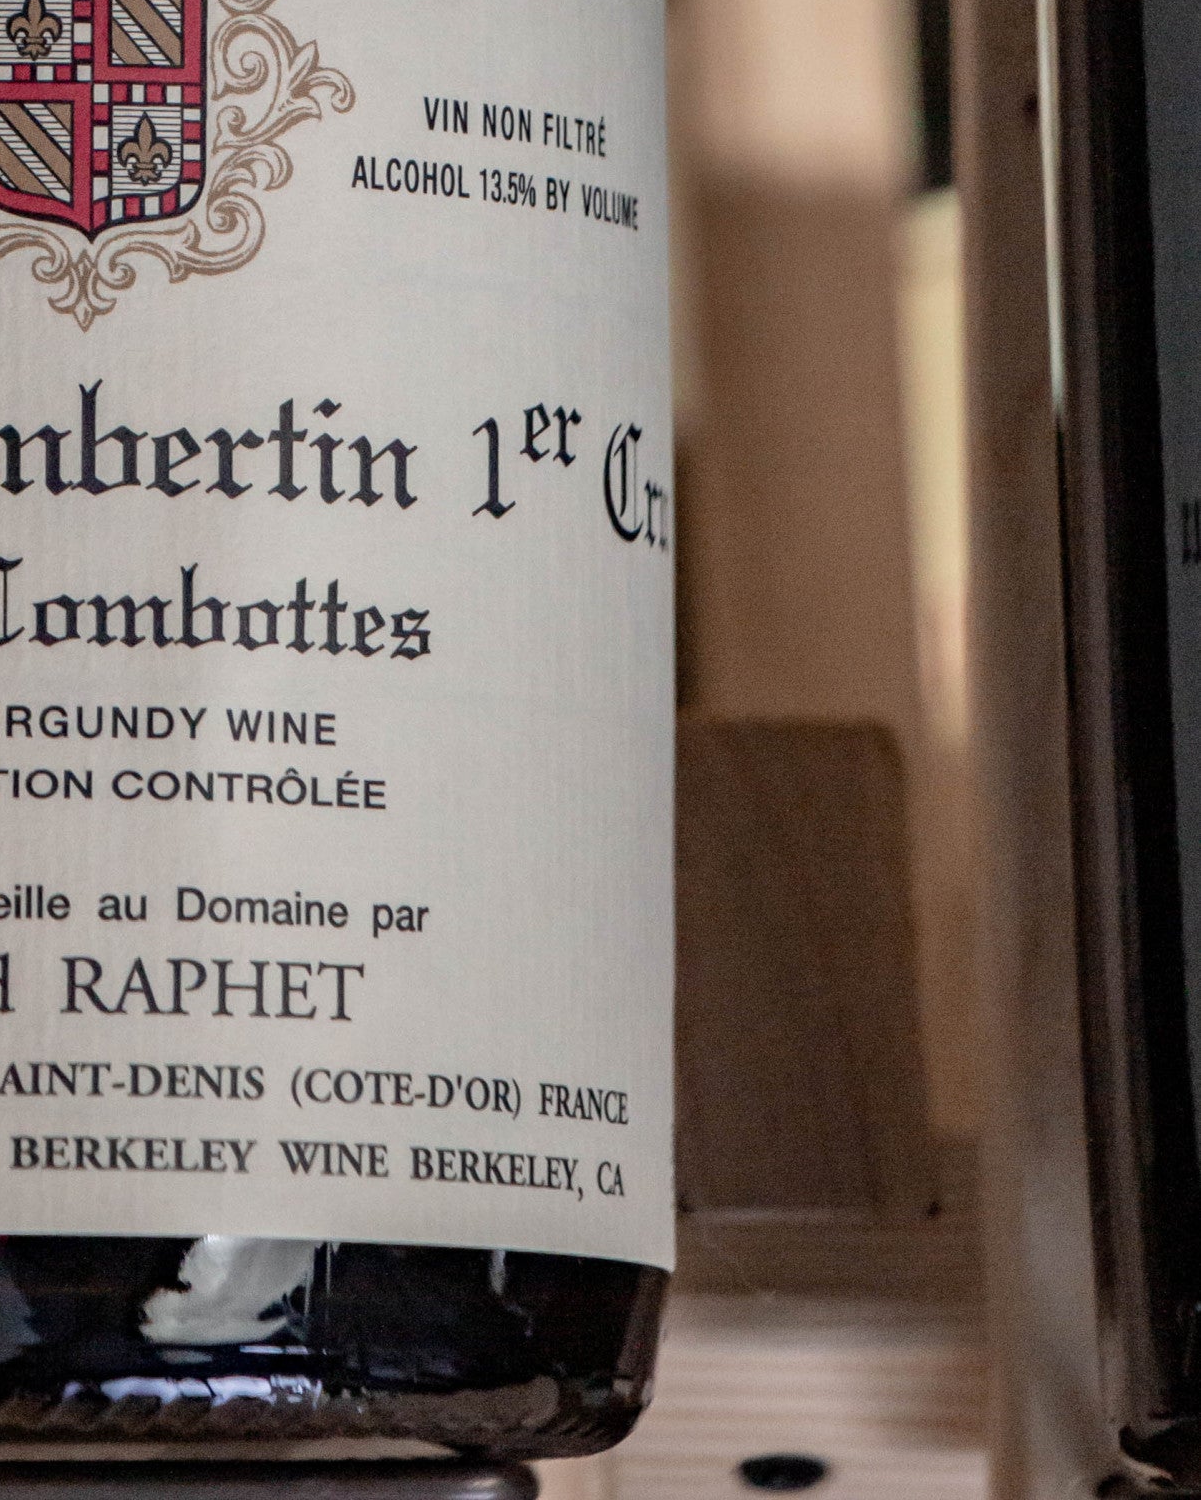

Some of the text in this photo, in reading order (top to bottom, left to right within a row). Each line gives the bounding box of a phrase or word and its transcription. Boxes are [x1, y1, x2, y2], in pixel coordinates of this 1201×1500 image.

[422, 95, 607, 159] VIN NON FILTRÉ
[350, 154, 639, 232] ALCOHOL 13.5% BY VOLUME
[470, 401, 583, 521] 1er
[225, 707, 338, 748] WINE
[110, 766, 388, 811] CONTRÔLÉE
[96, 892, 148, 923] au
[175, 885, 350, 930] Domaine
[371, 902, 431, 940] par
[59, 955, 366, 1023] RAPHET
[289, 1065, 523, 1121] (COTE-D'OR)
[537, 1081, 630, 1126] FRANCE
[9, 1134, 258, 1175] BERKELEY
[277, 1139, 390, 1179] WINE
[409, 1145, 585, 1203] BERKELEY,
[595, 1159, 626, 1198] CA
